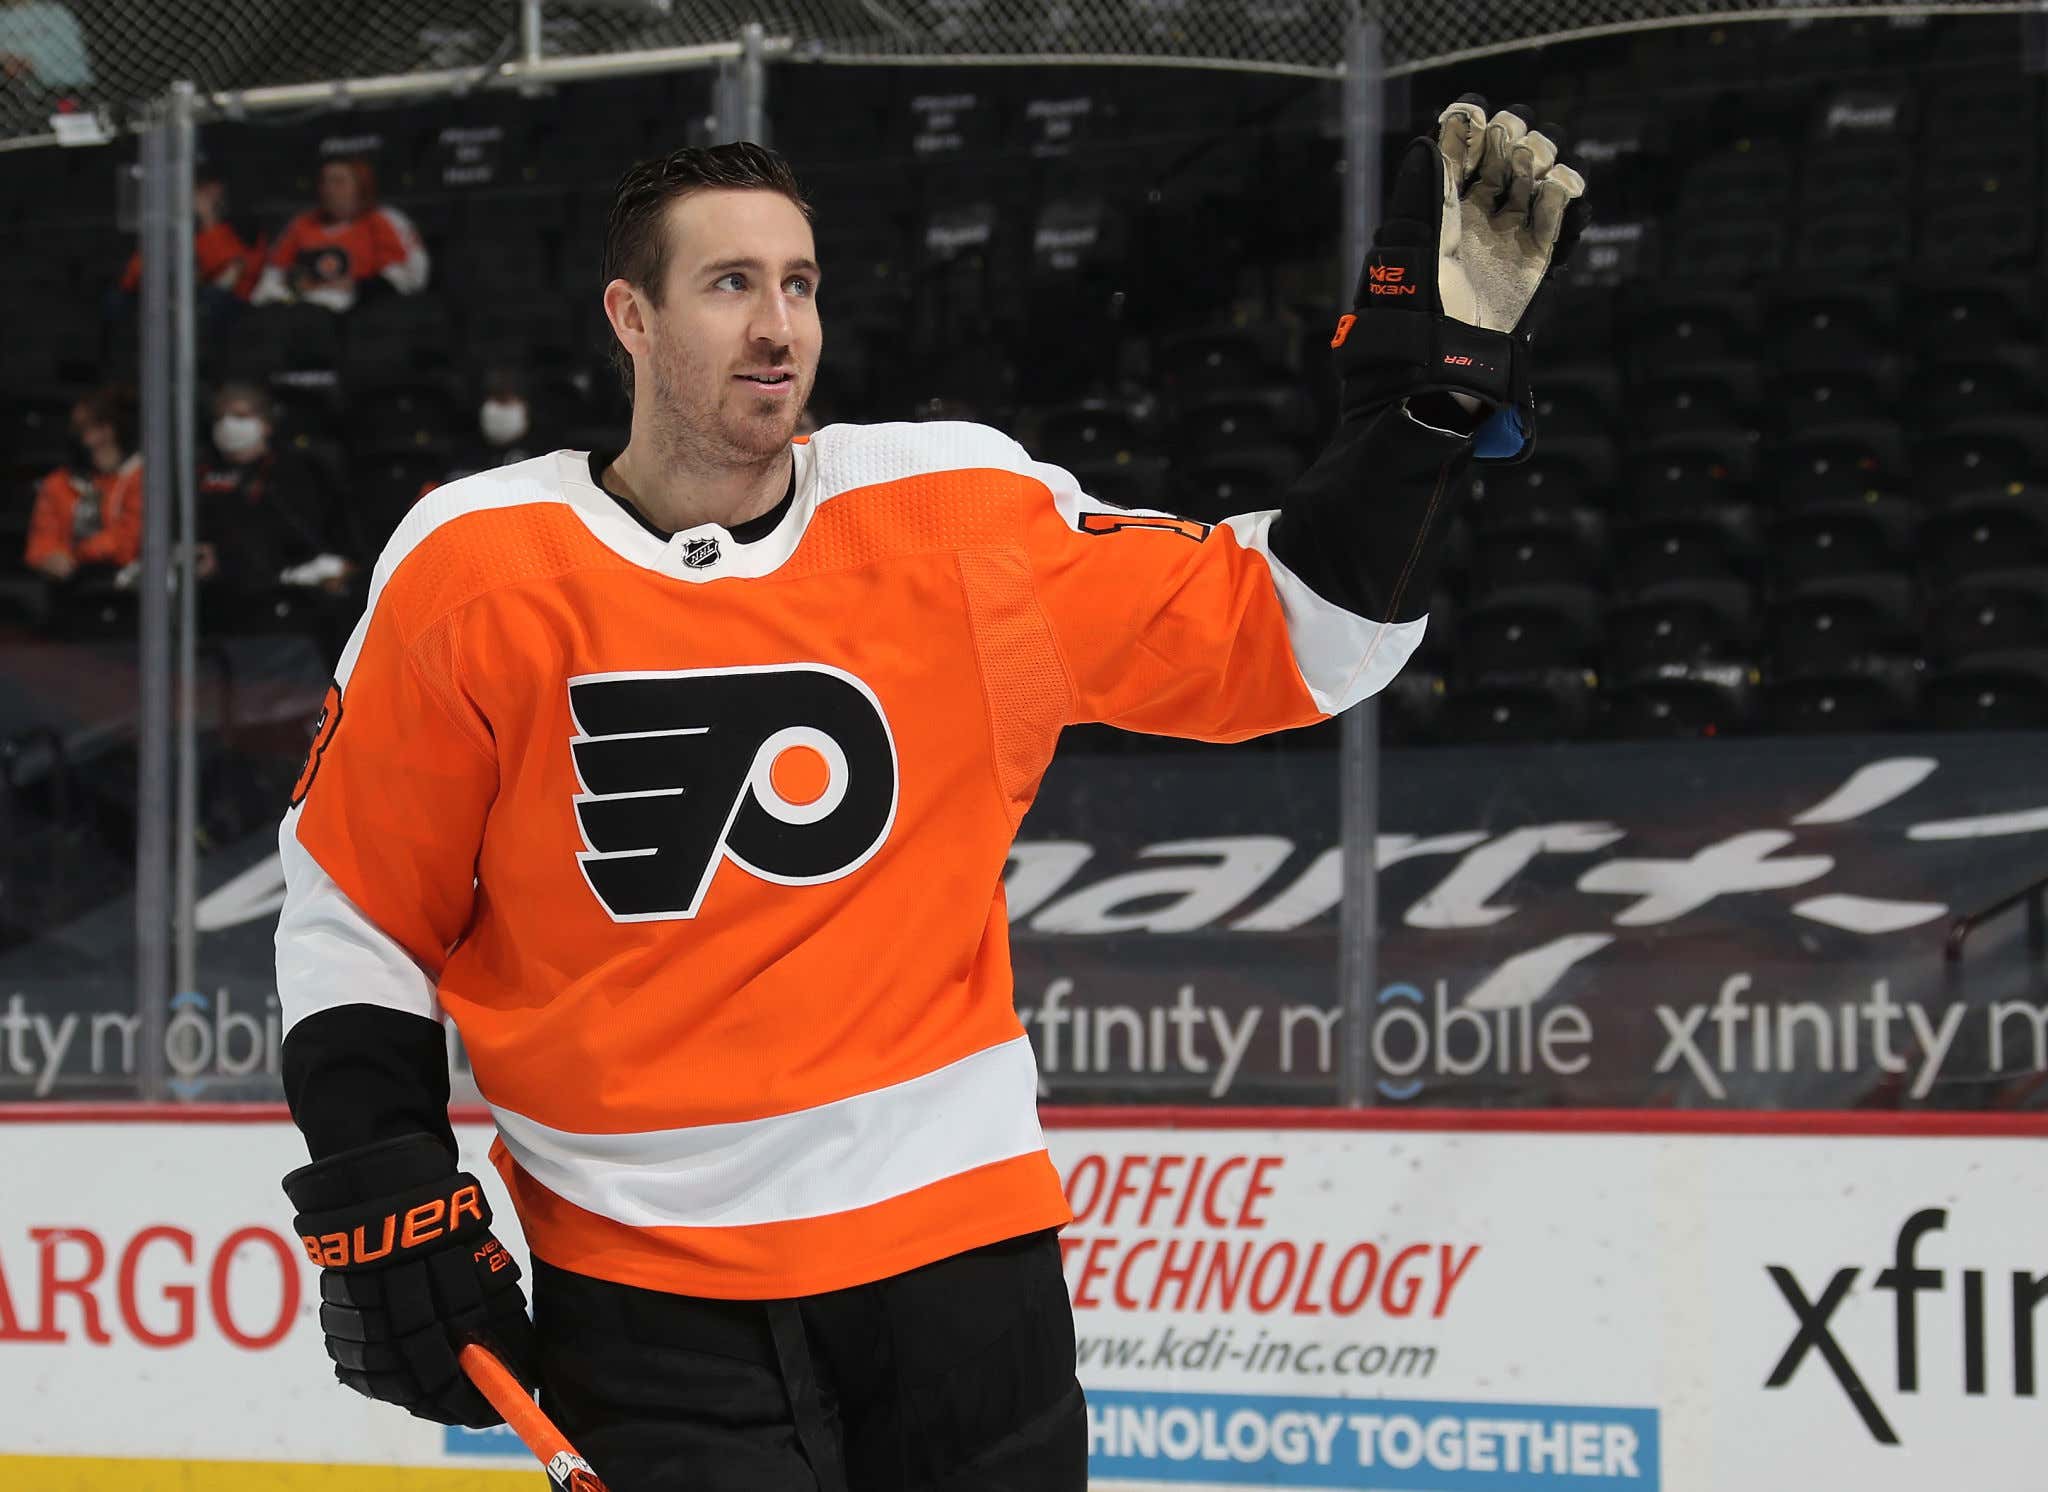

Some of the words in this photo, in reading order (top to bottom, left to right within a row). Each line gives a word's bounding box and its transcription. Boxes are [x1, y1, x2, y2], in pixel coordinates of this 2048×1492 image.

[1021, 977, 1263, 1098] finity
[1280, 979, 1594, 1078] mobile
[1654, 974, 1968, 1100] xfinity
[302, 1184, 483, 1268] BAUER
[1063, 1153, 1286, 1230] OFFICE
[1059, 1237, 1482, 1319] TECHNOLOGY
[1348, 1414, 1641, 1478] TOGETHER
